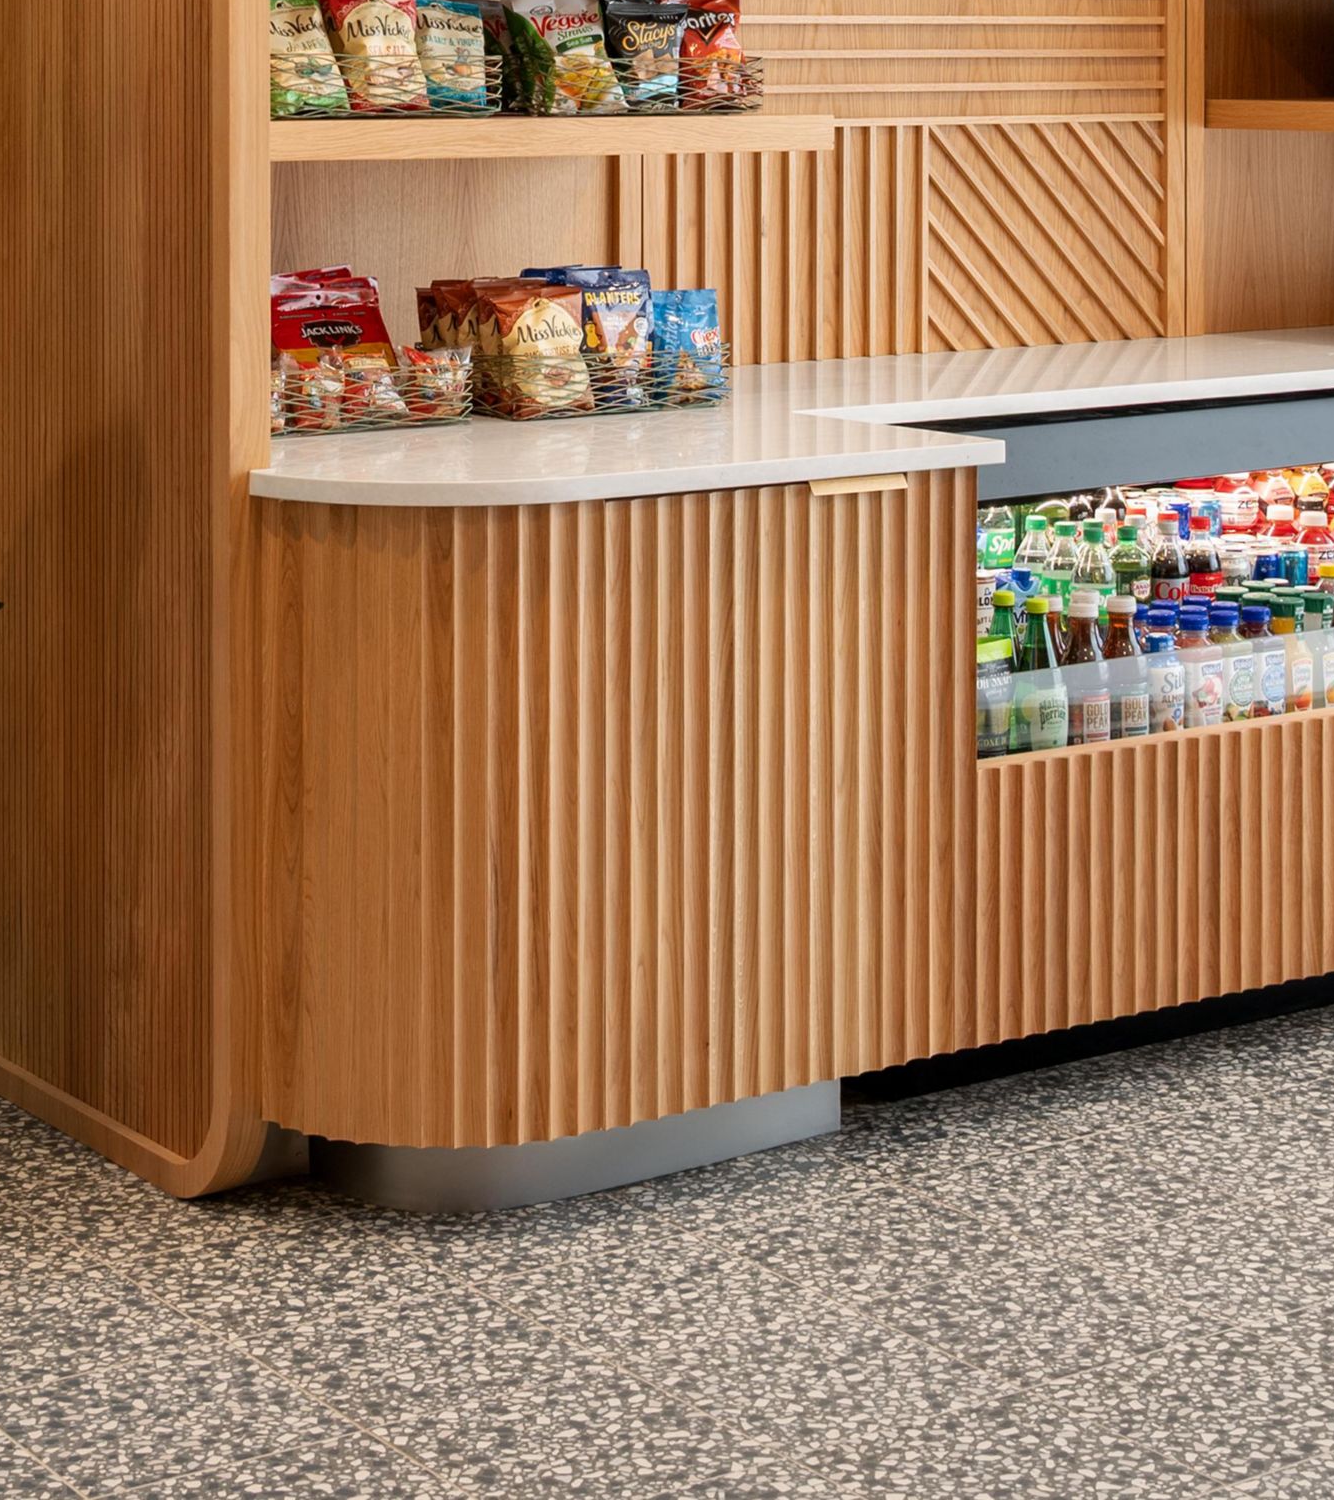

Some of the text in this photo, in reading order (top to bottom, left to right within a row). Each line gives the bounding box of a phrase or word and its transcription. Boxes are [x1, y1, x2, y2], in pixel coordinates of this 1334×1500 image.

[347, 19, 382, 42] Miss
[530, 12, 599, 38] Veggie
[557, 26, 594, 42] Straws
[622, 20, 677, 51] Stacy's
[584, 290, 643, 306] PLANTERS
[301, 325, 329, 339] JACK
[517, 326, 549, 345] Miss
[989, 535, 1015, 555] Spr
[1161, 671, 1182, 694] Sil
